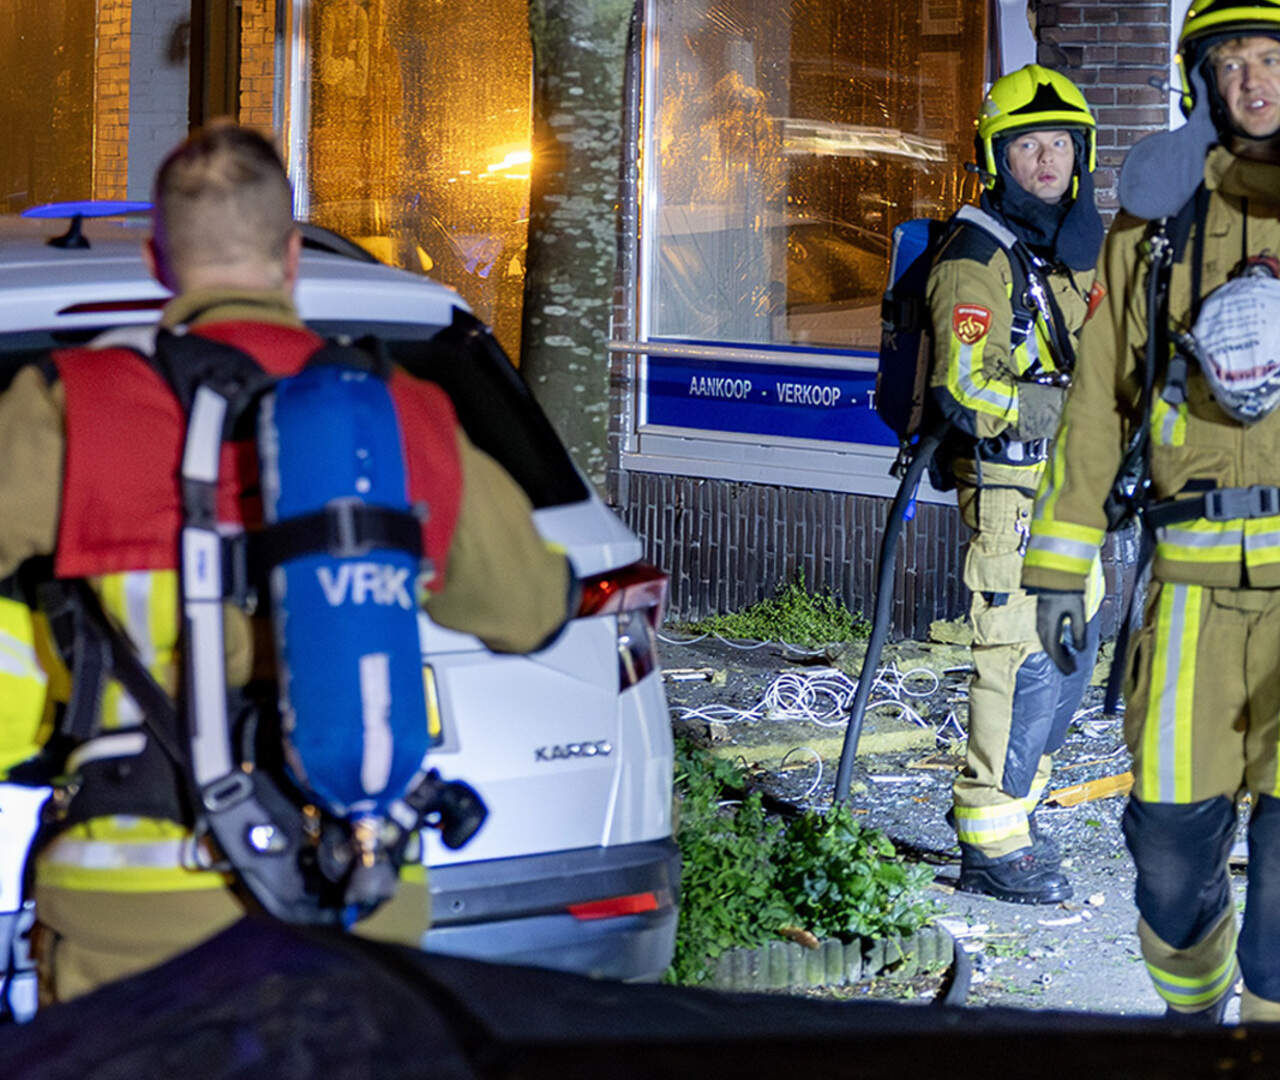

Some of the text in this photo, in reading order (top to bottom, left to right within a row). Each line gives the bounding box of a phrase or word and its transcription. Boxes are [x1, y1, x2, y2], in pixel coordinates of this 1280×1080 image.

[689, 376, 752, 399] AANKOOP
[776, 382, 841, 406] VERKOOP
[316, 562, 412, 610] VRK
